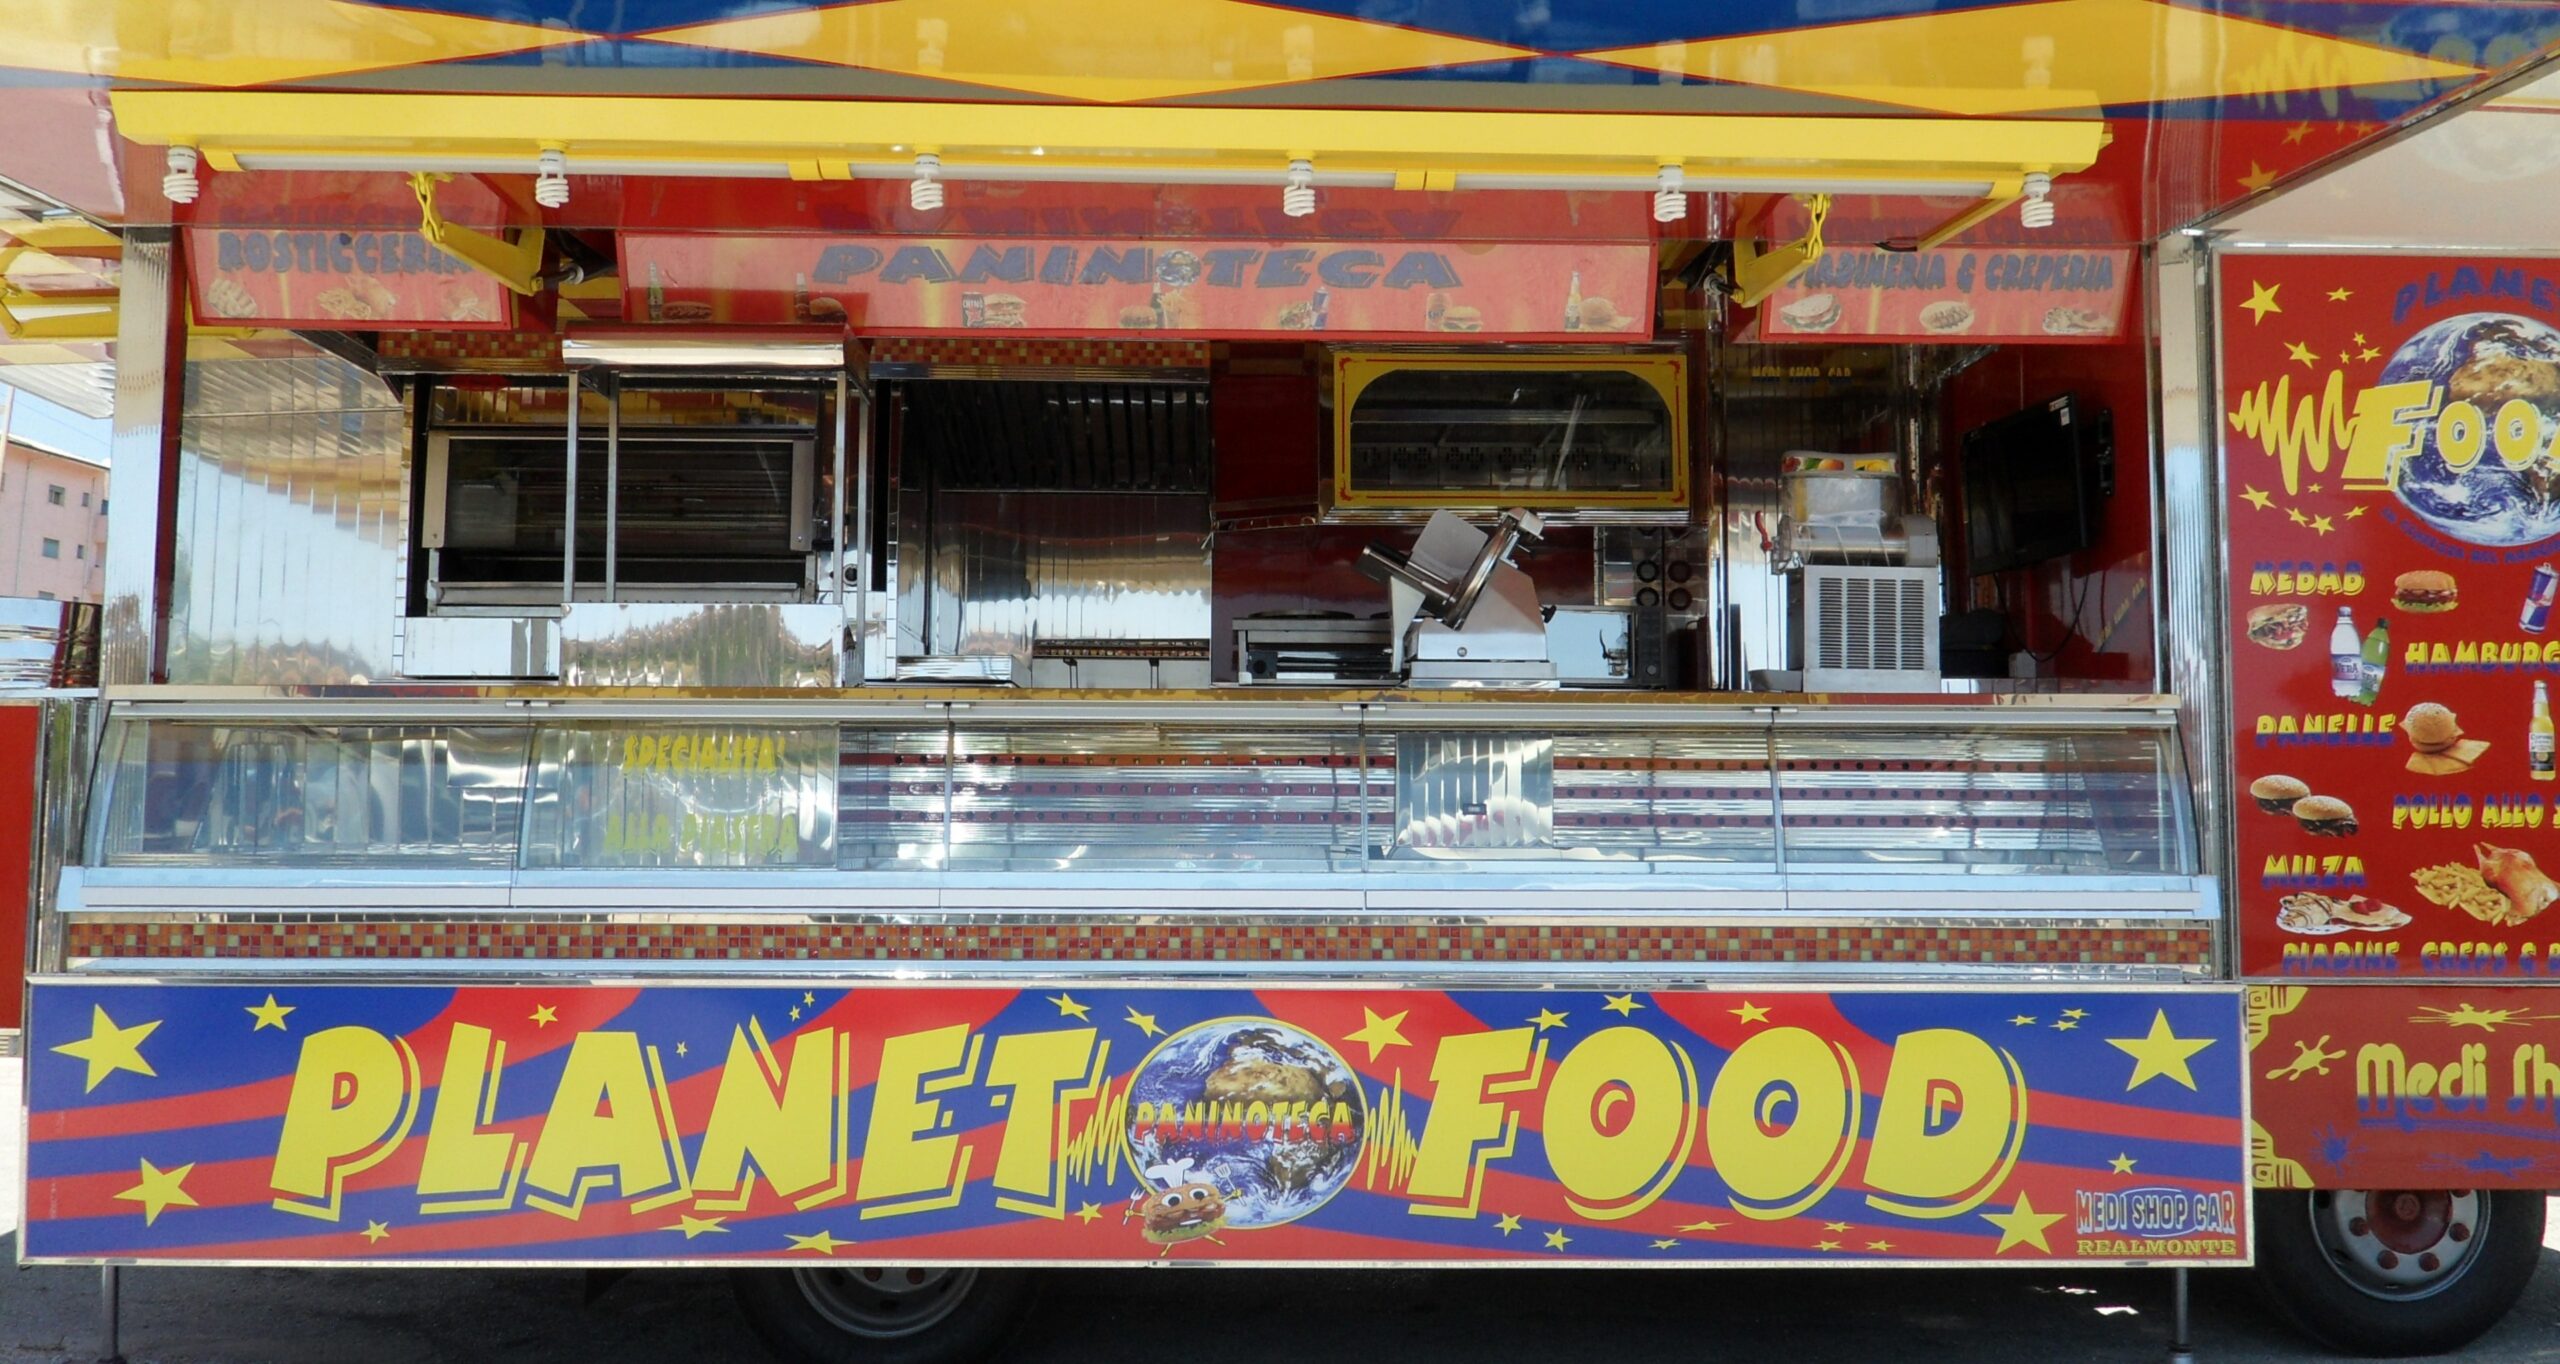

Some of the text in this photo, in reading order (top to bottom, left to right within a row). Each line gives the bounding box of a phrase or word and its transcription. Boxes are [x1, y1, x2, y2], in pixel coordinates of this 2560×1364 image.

[1985, 254, 2114, 293] CREPERIA
[2392, 264, 2560, 325] PLANE
[2250, 560, 2366, 596] KEBAB
[2255, 713, 2397, 748] PANELLE
[2392, 792, 2473, 831] POLLO
[2481, 792, 2544, 829] ALLO
[2261, 854, 2368, 889] MILZA
[2281, 940, 2400, 975] PIADINE
[270, 1013, 2028, 1224] PLANET FOOD
[1134, 1099, 1356, 1145] PANINOTECA
[2075, 1189, 2237, 1236] MEDI SHOP CAR
[2076, 1239, 2237, 1256] REALMONTE
